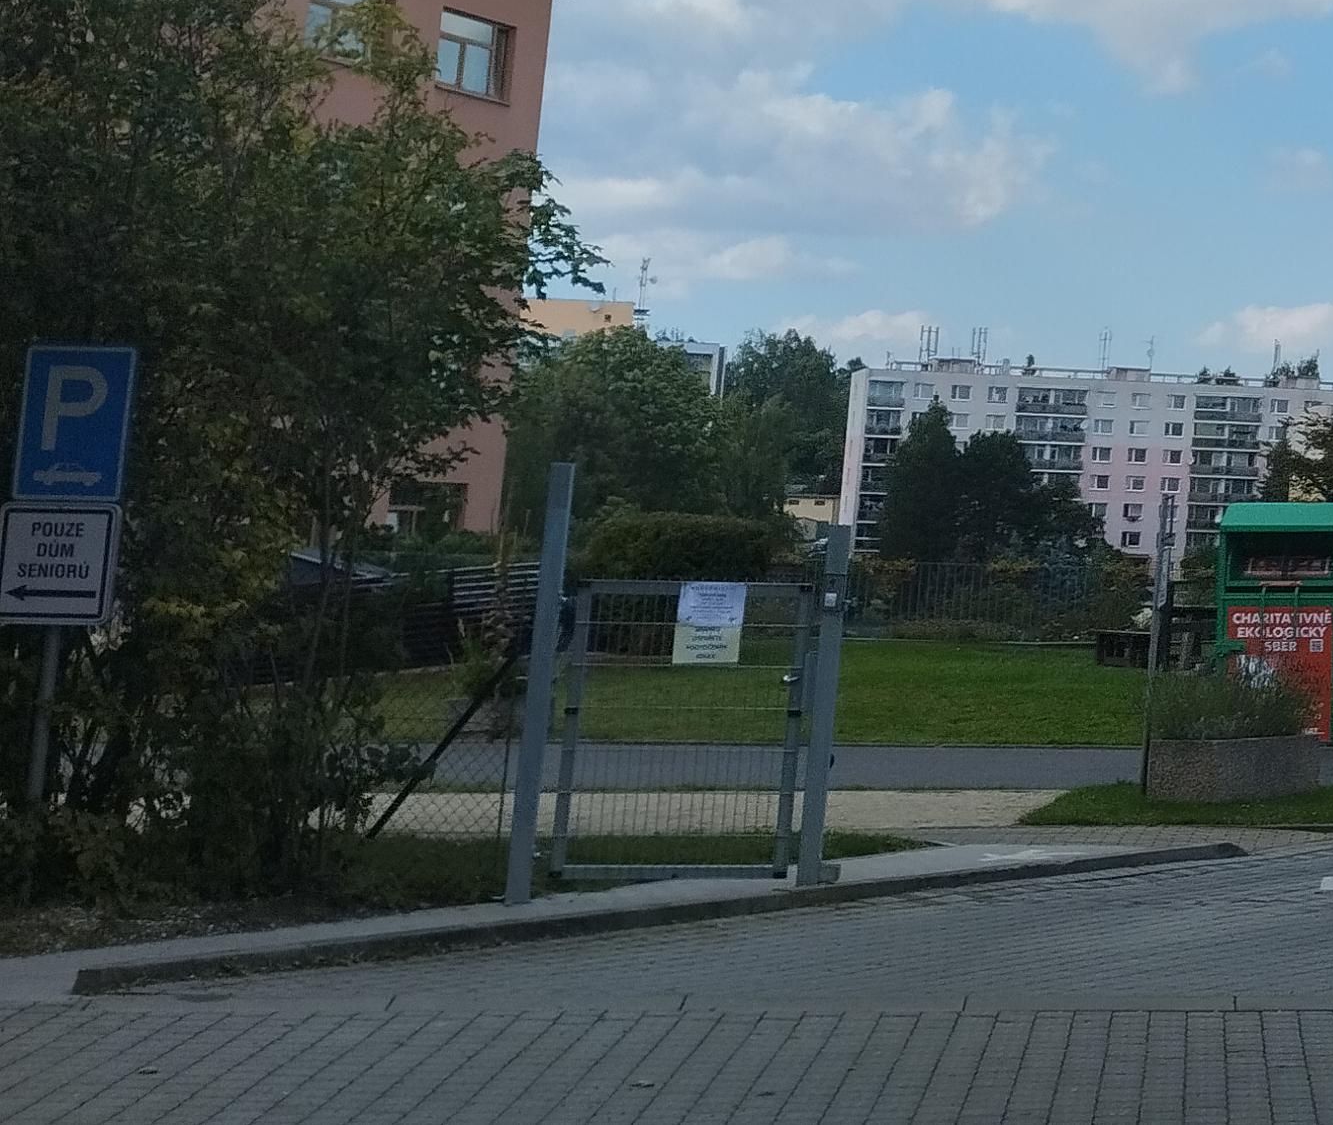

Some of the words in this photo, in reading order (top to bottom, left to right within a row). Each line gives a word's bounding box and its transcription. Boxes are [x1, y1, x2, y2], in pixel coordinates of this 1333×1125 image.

[41, 364, 108, 451] P
[31, 522, 85, 537] POUZE
[36, 539, 75, 557] DŮM
[17, 560, 90, 579] SENIORŮ
